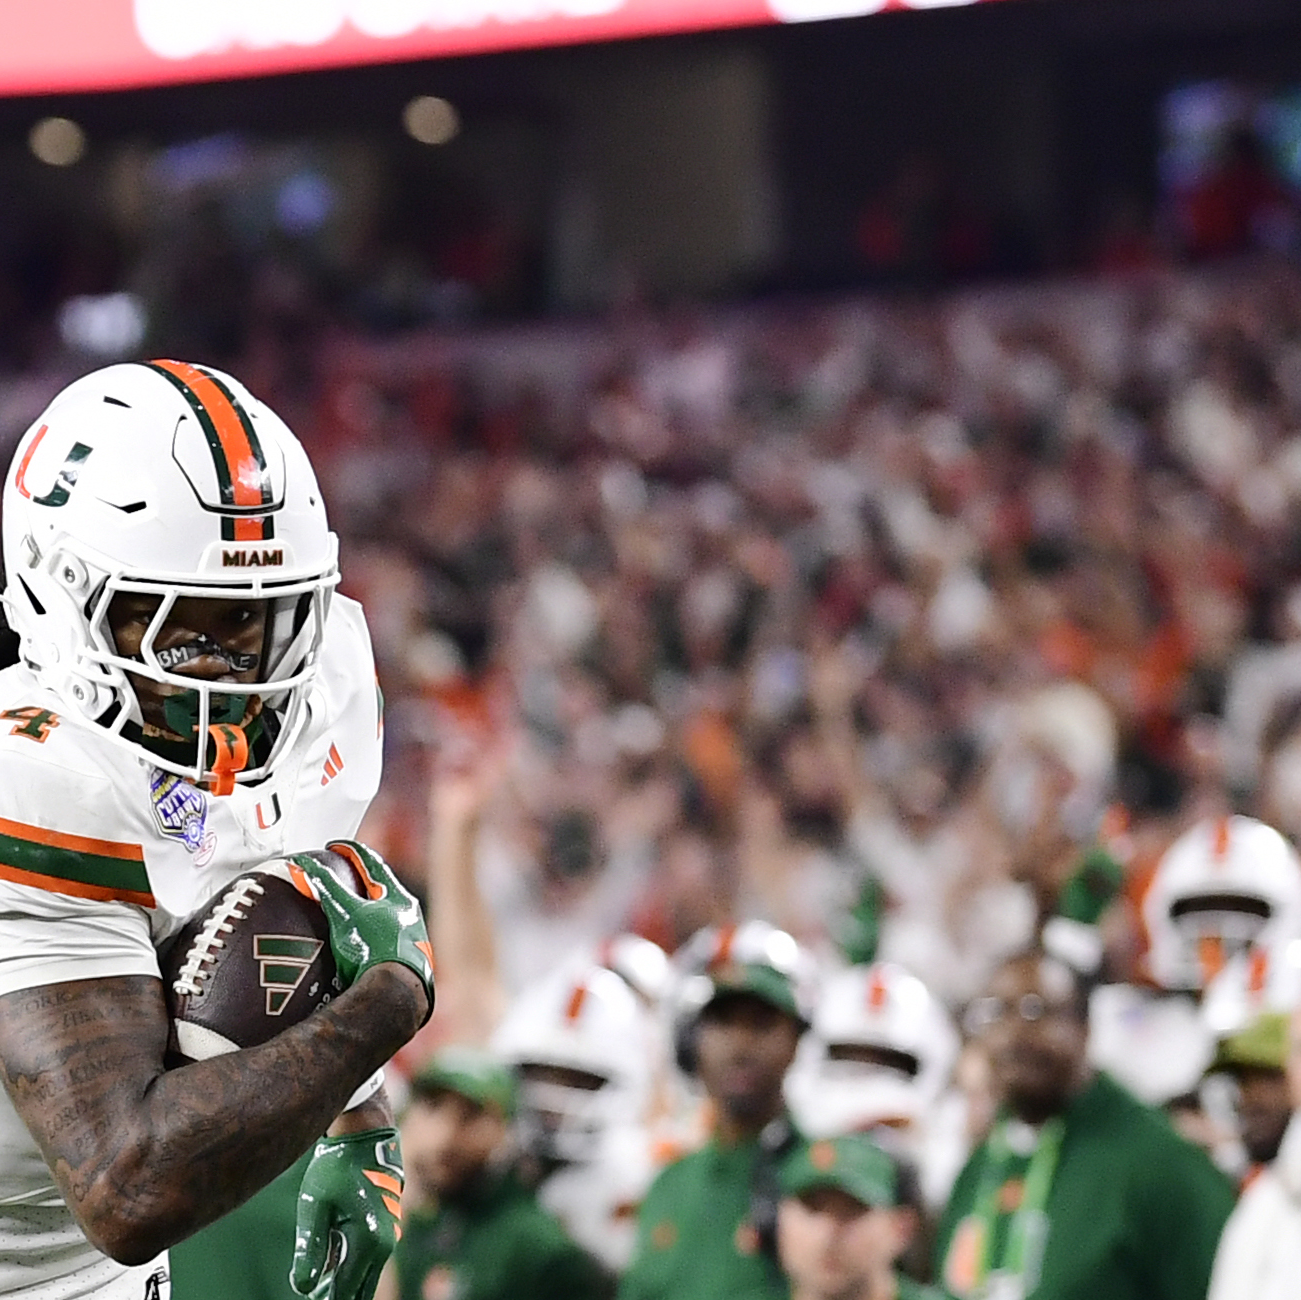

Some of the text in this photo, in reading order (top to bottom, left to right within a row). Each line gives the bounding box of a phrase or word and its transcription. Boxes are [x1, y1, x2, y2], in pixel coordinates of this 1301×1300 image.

[14, 423, 94, 508] U
[222, 549, 283, 567] MIAMI
[255, 791, 282, 830] U
